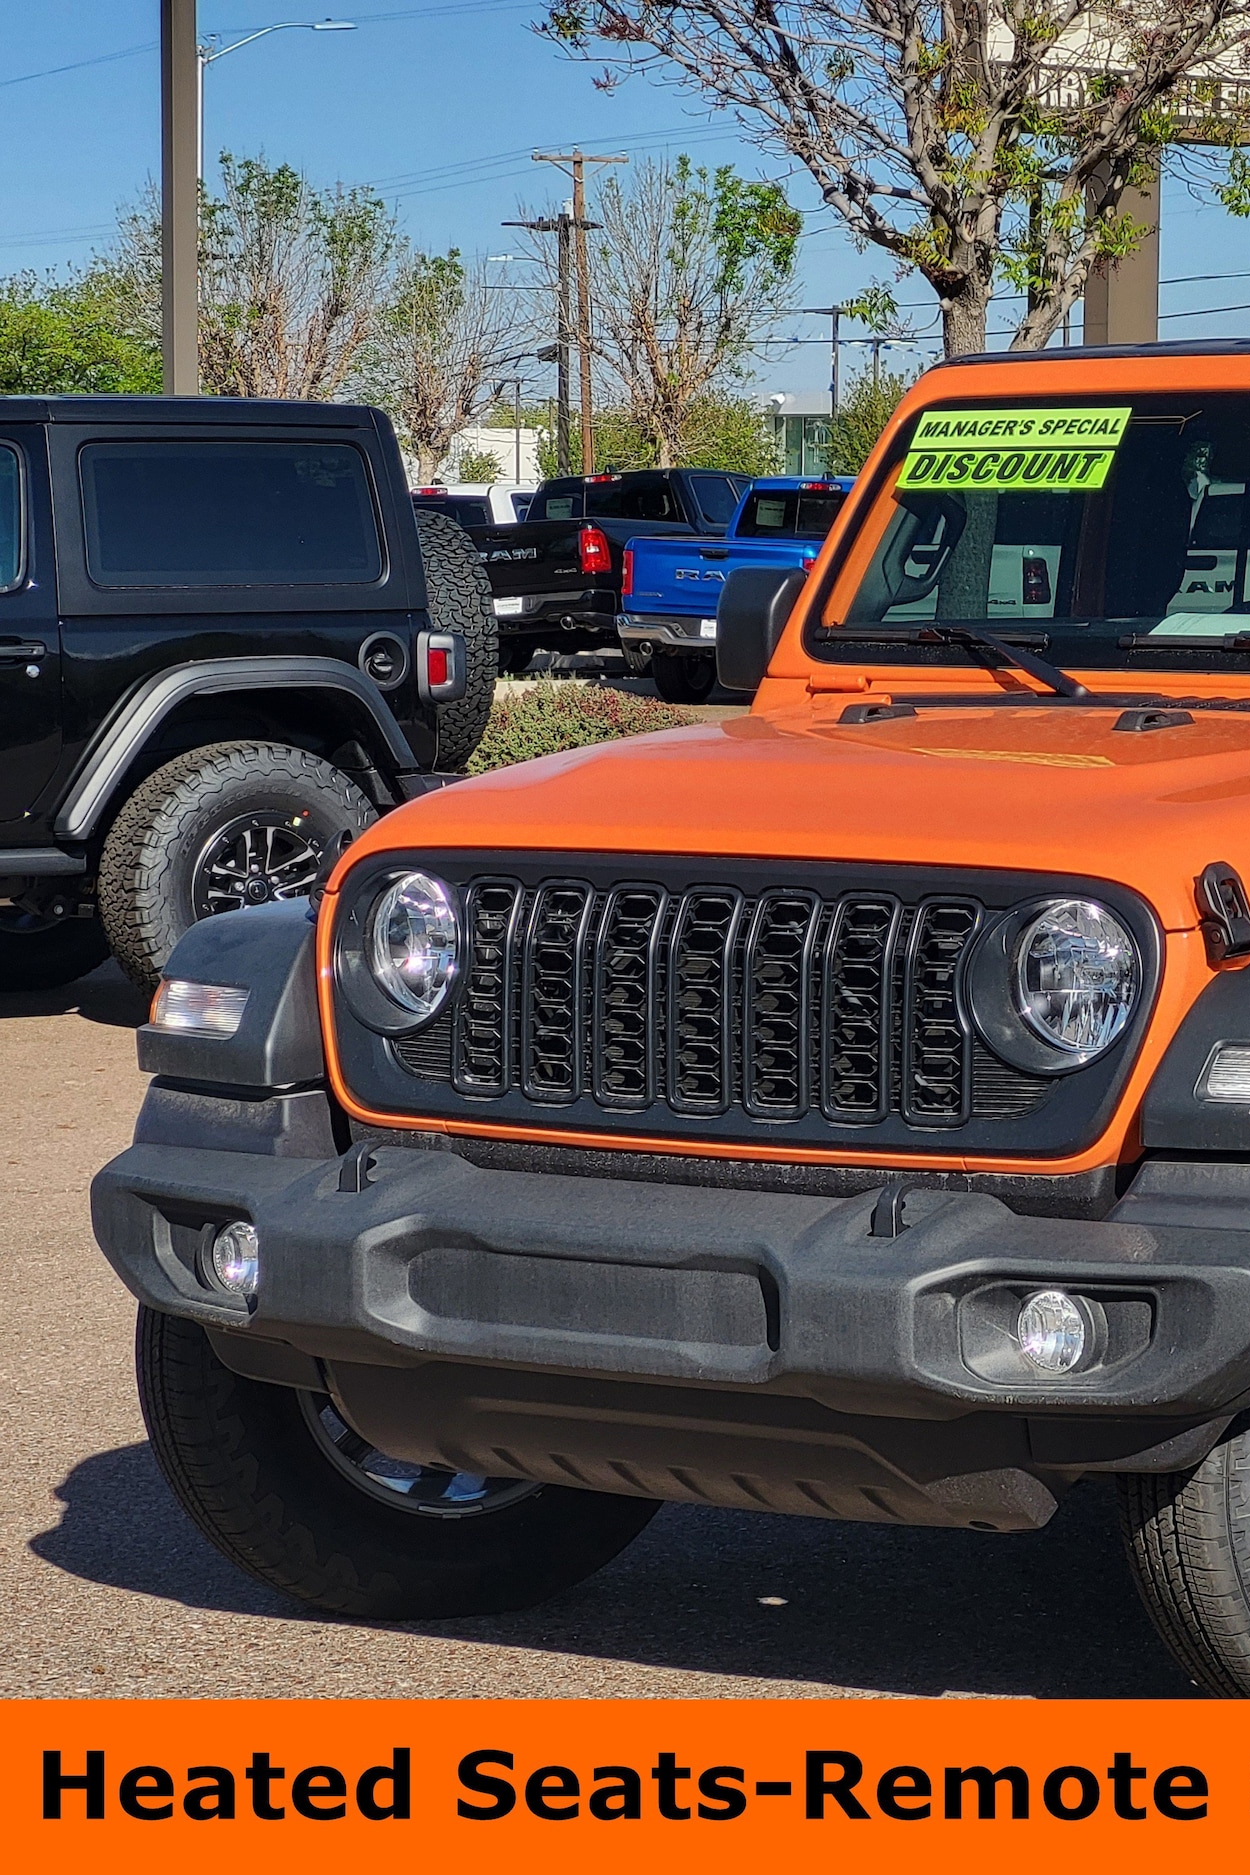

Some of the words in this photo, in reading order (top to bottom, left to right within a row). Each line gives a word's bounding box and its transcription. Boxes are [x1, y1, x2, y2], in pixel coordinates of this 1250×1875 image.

[918, 417, 1034, 438] MANAGER'S
[1038, 417, 1120, 435] SPECIAL
[906, 453, 1105, 484] DISCOUNT
[675, 569, 731, 581] RA
[1177, 580, 1236, 593] AM
